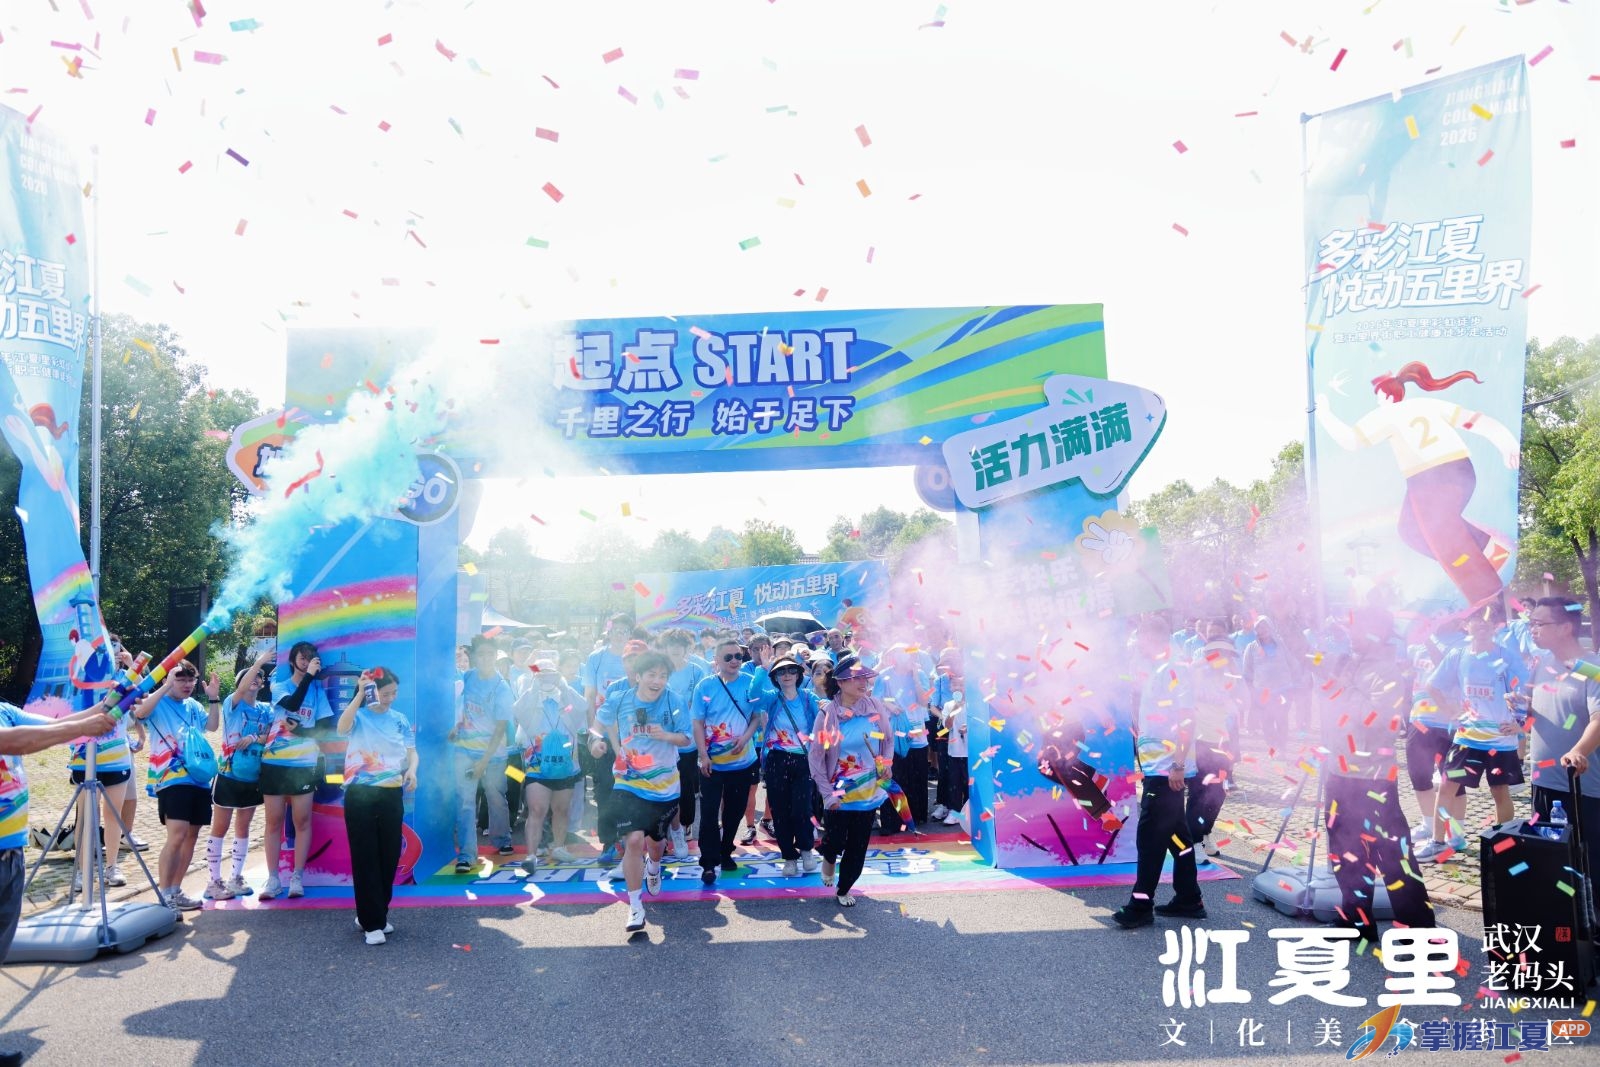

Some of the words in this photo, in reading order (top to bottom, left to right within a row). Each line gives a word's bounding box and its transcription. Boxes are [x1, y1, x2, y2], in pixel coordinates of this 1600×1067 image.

[0, 249, 71, 307] 江夏
[1309, 214, 1484, 283] 多彩江夏
[1322, 258, 1524, 318] 悦动五里界
[551, 329, 681, 393] 起点
[694, 327, 856, 389] START
[556, 402, 694, 438] 千里之行
[714, 396, 855, 435] 始于足下
[969, 402, 1132, 491] 活力满满
[671, 586, 747, 622] 多彩江夏
[753, 572, 840, 606] 悦动五里界
